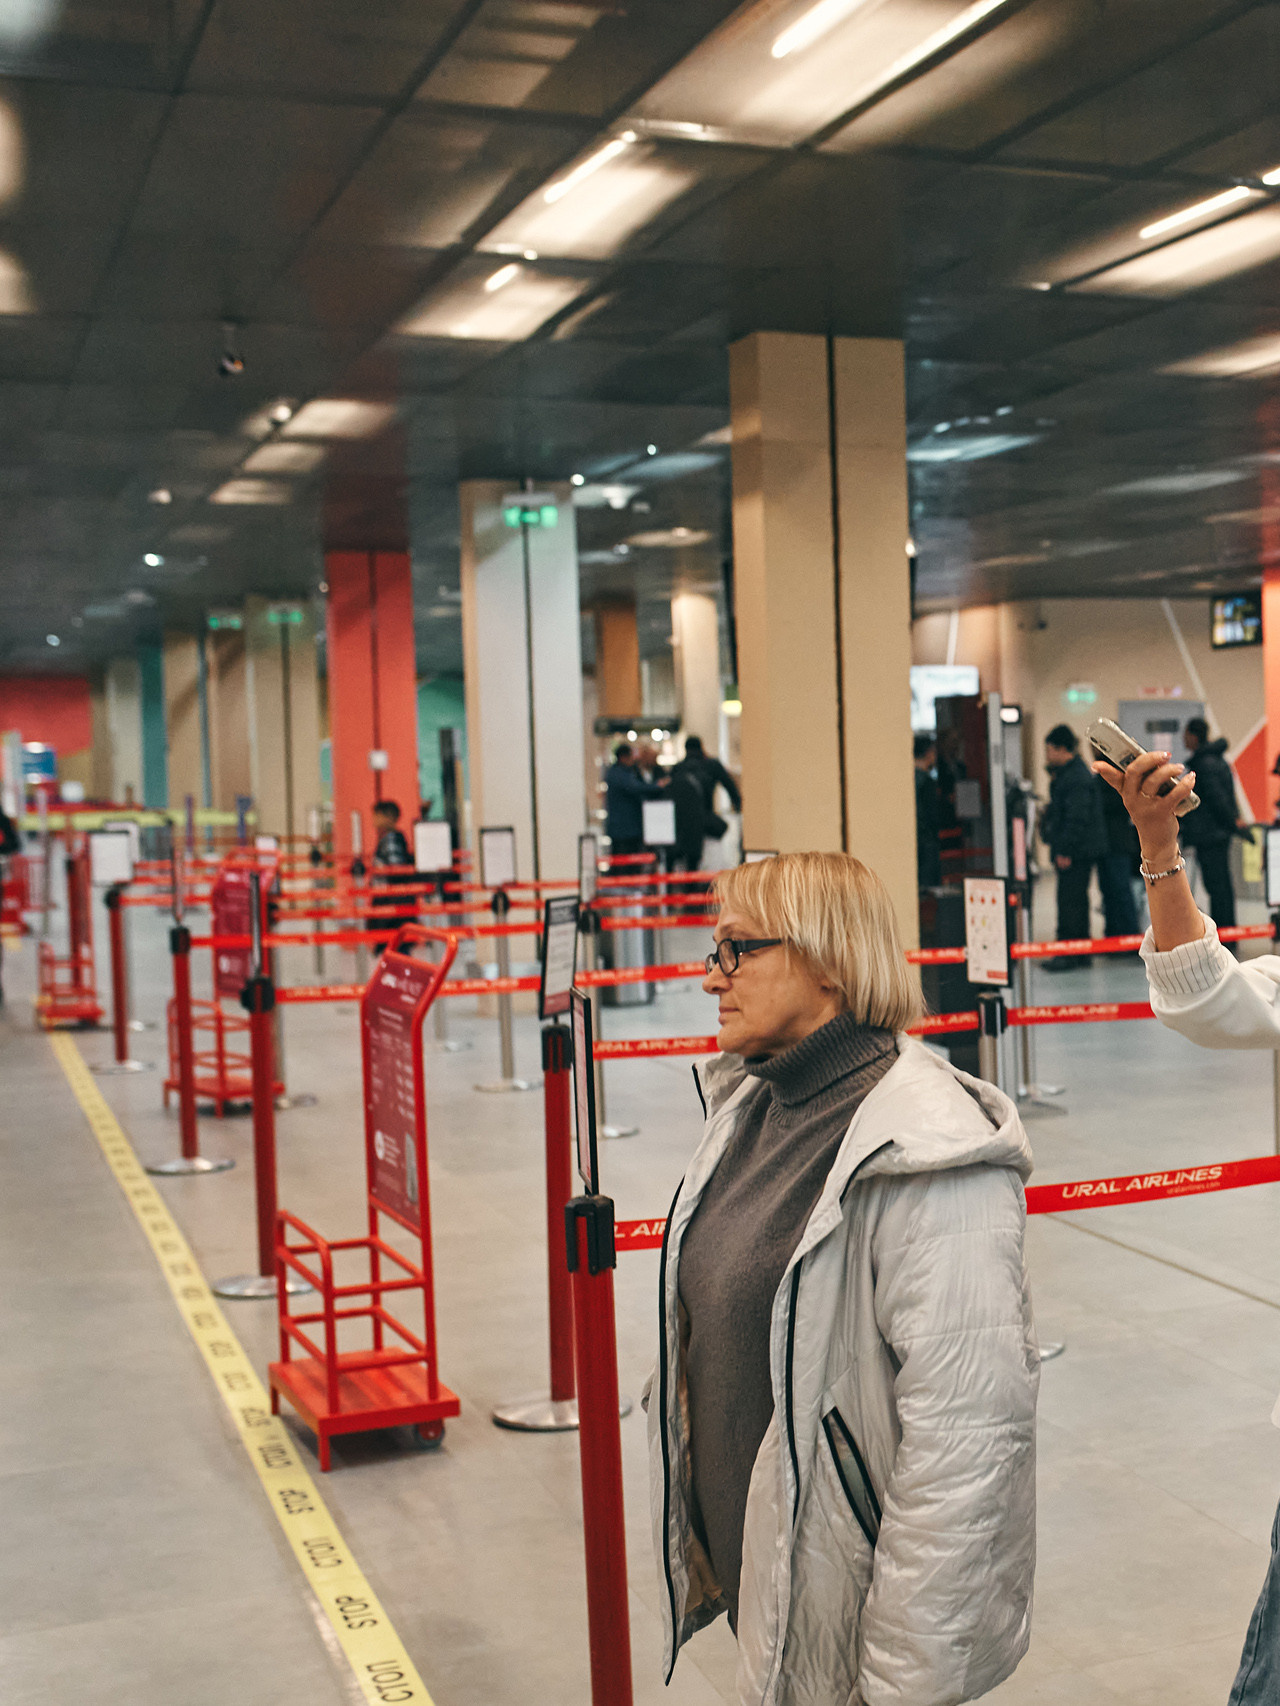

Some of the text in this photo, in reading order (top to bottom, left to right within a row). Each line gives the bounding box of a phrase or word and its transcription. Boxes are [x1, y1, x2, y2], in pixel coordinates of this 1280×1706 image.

[1062, 1166, 1223, 1199] URAL AIRLINES
[302, 1536, 343, 1568] СТОП
[335, 1595, 378, 1630] STOP
[366, 1660, 413, 1703] СТОП
